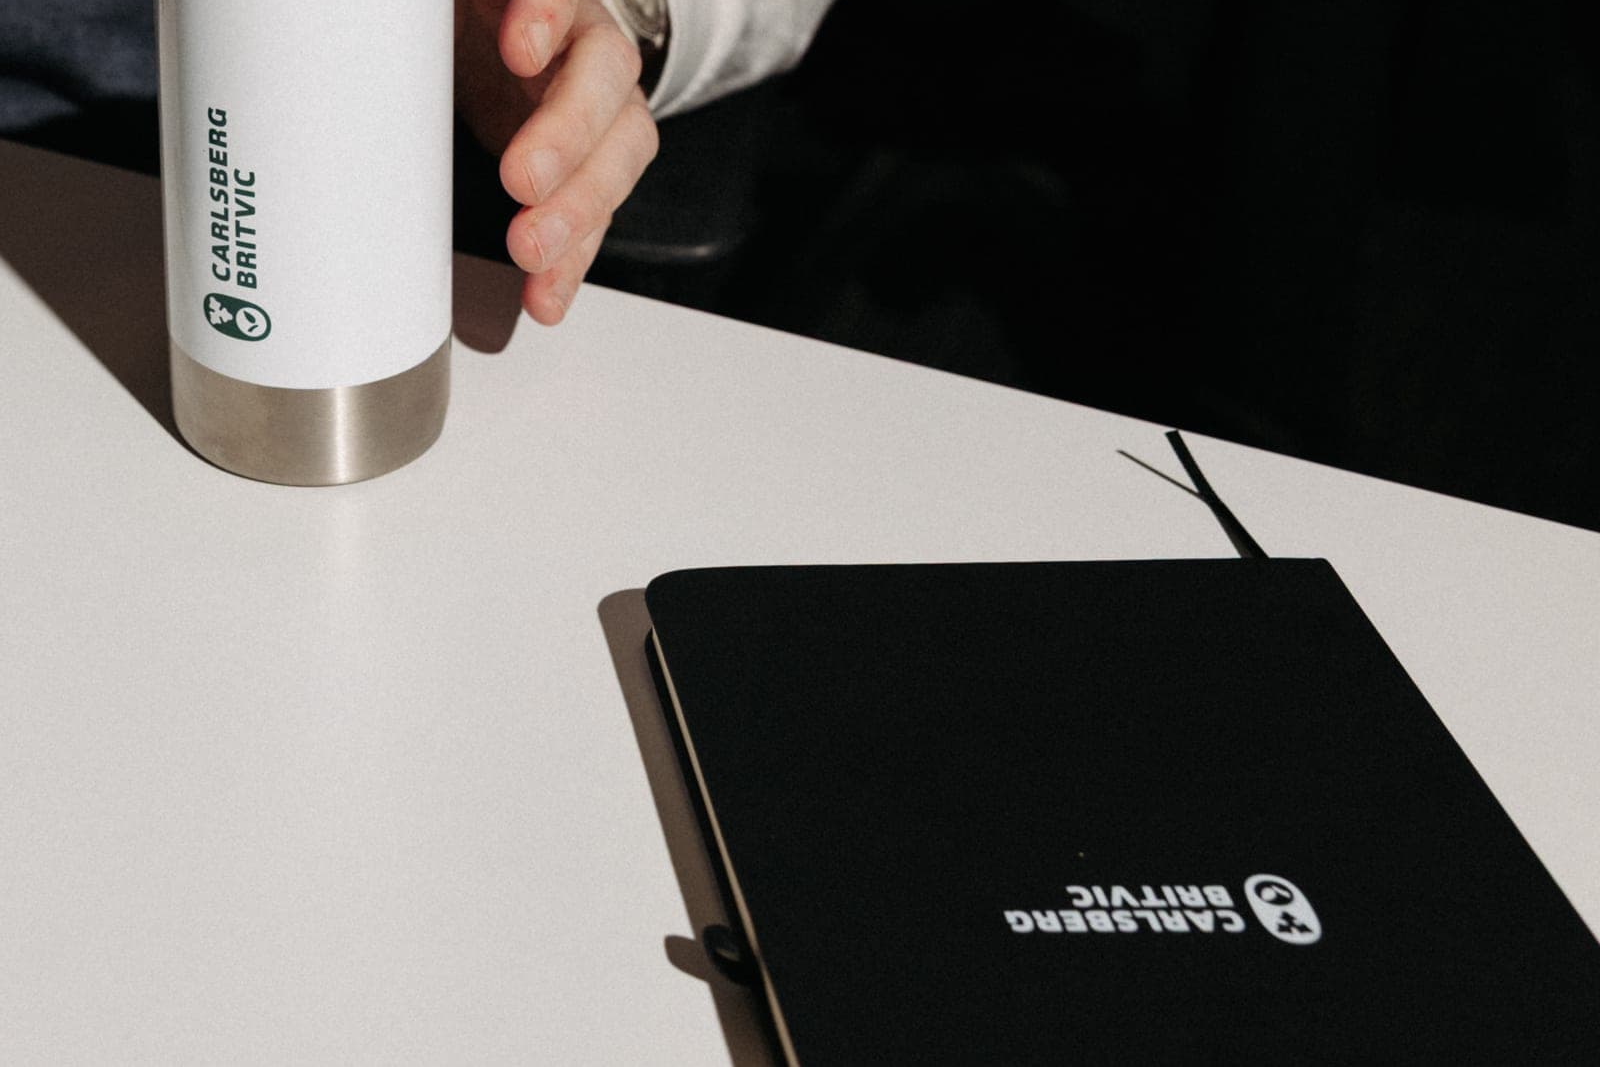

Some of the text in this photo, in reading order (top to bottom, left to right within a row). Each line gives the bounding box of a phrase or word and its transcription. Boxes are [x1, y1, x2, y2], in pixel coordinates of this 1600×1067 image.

[207, 106, 231, 283] CARLSBERG
[234, 168, 258, 290] BRITVIC
[1003, 910, 1247, 933] CARLSBERG
[1066, 885, 1234, 908] BRITVIC
